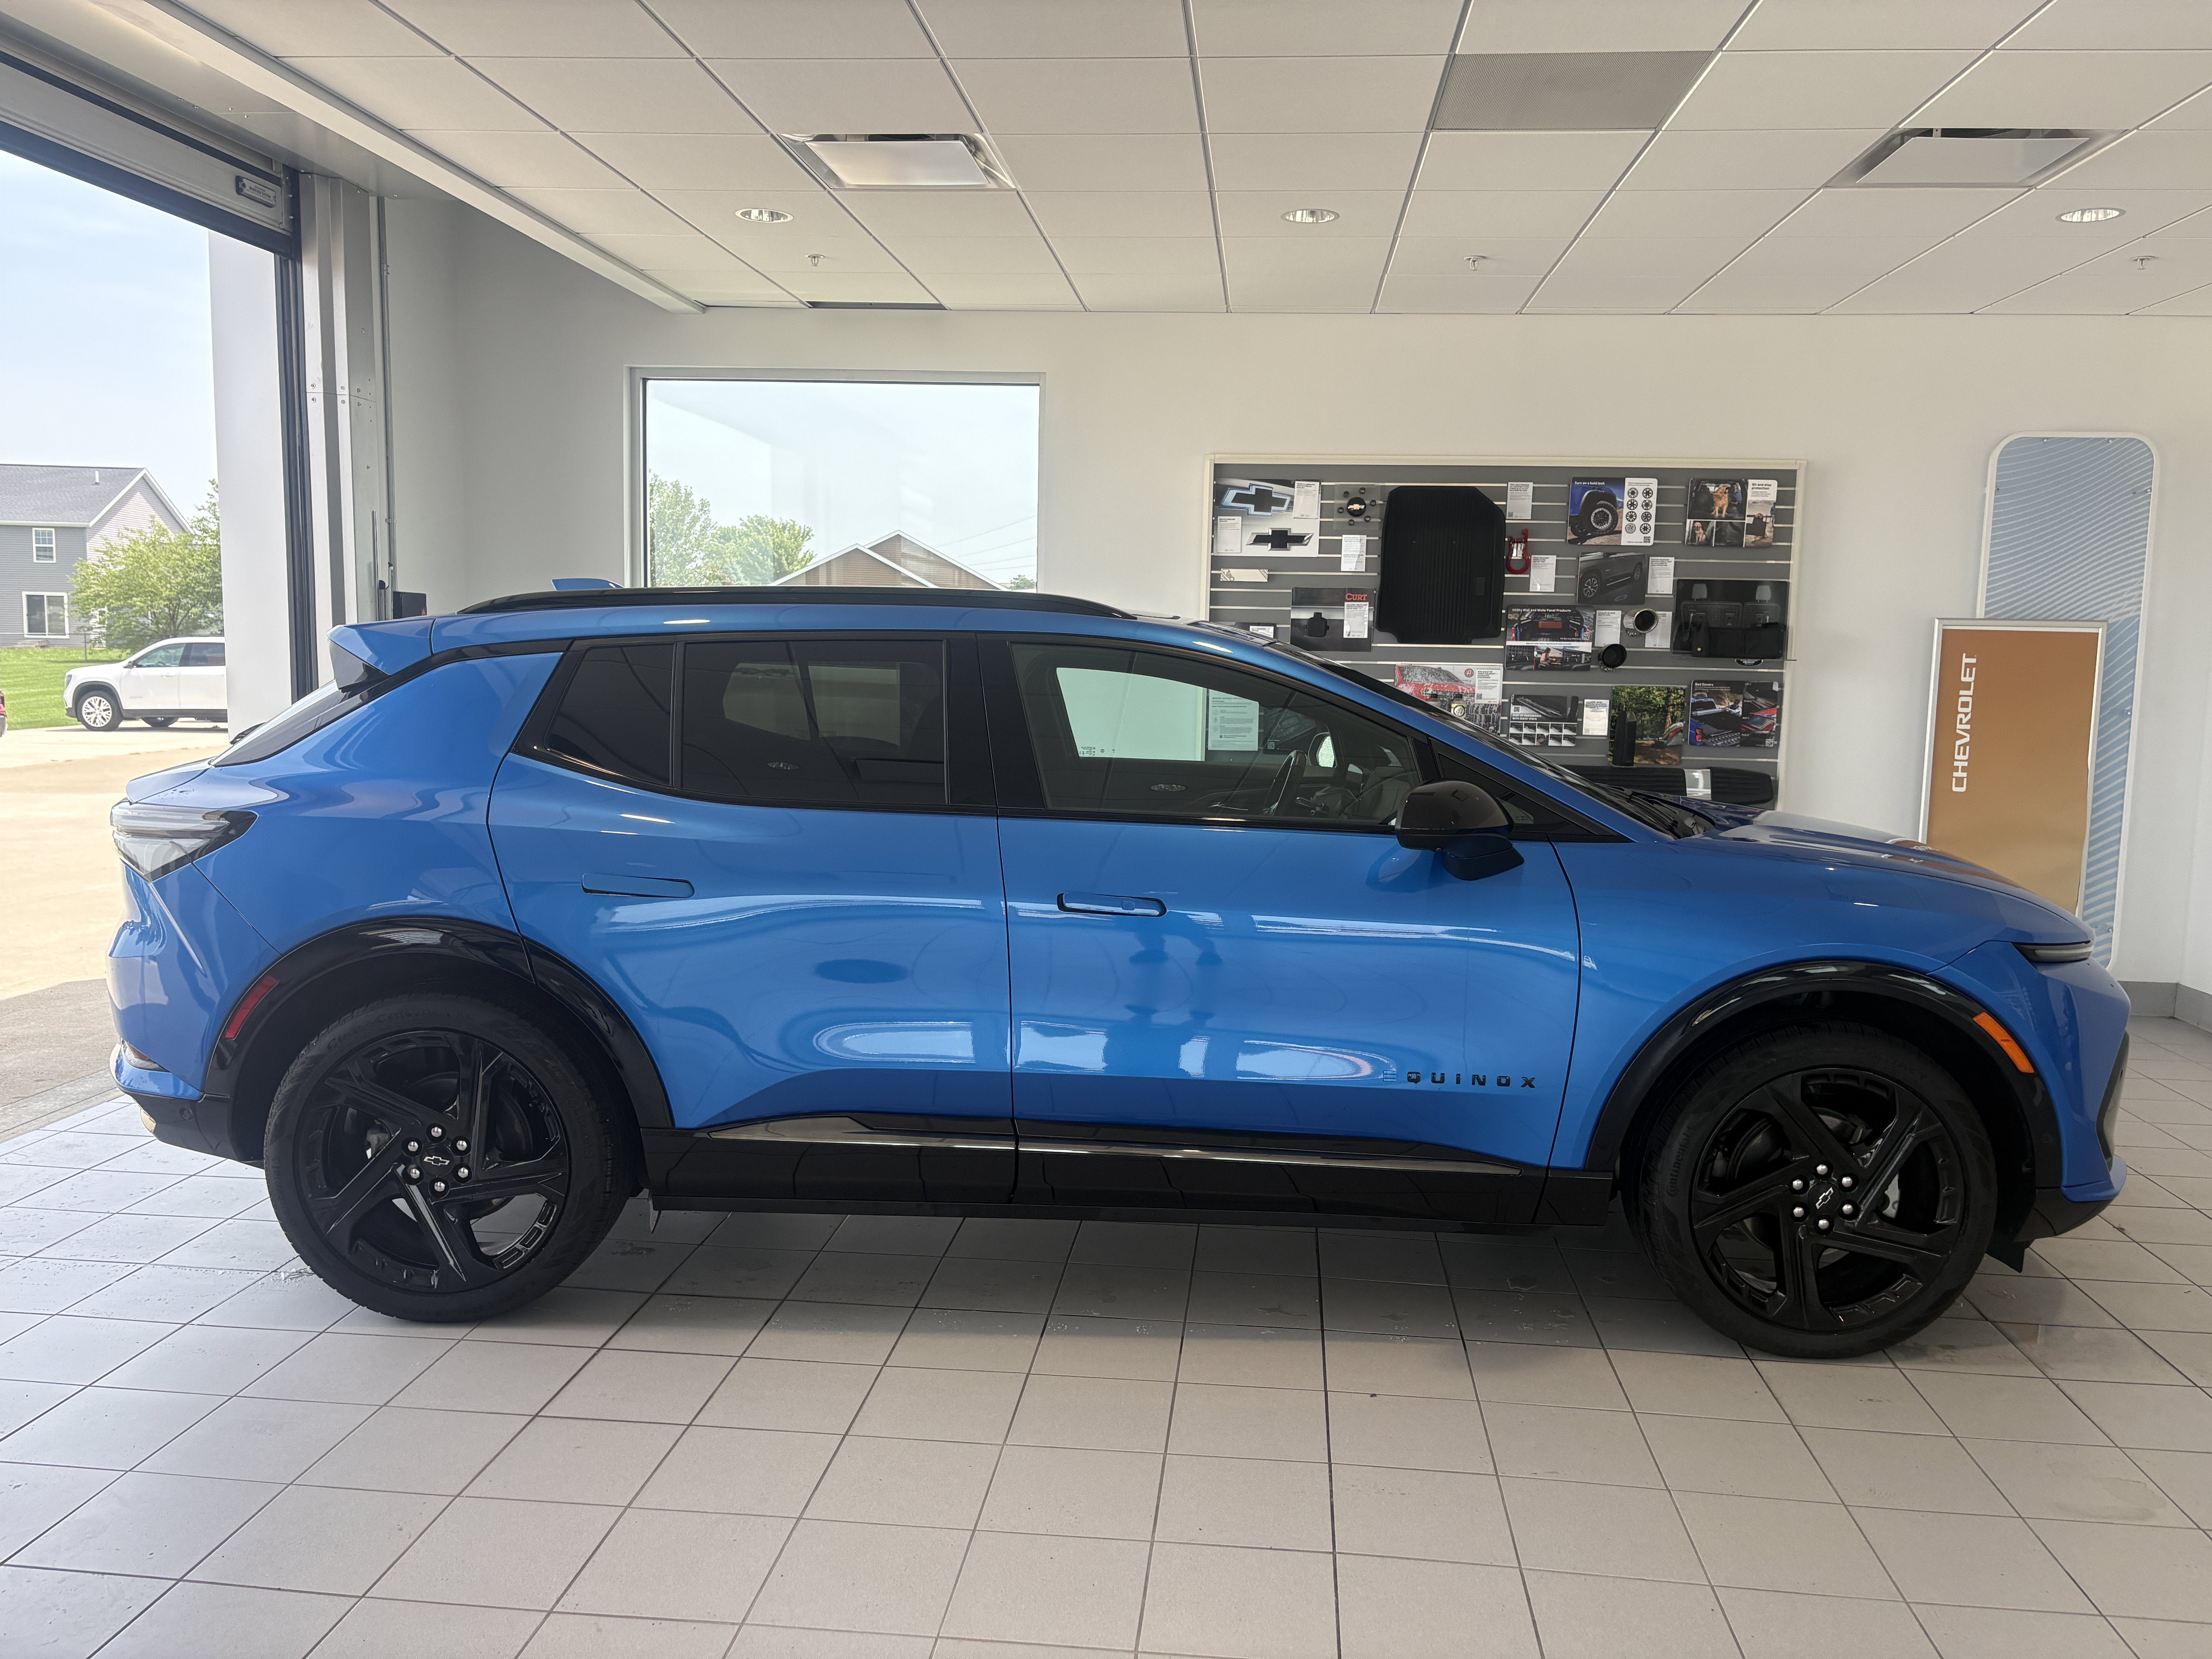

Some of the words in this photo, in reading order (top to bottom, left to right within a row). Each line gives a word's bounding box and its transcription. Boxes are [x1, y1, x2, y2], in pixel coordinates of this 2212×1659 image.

[1952, 653, 1977, 792] CHEVROLET
[1383, 1070, 1536, 1089] EQUINOX
[1666, 1132, 1692, 1197] Continental
